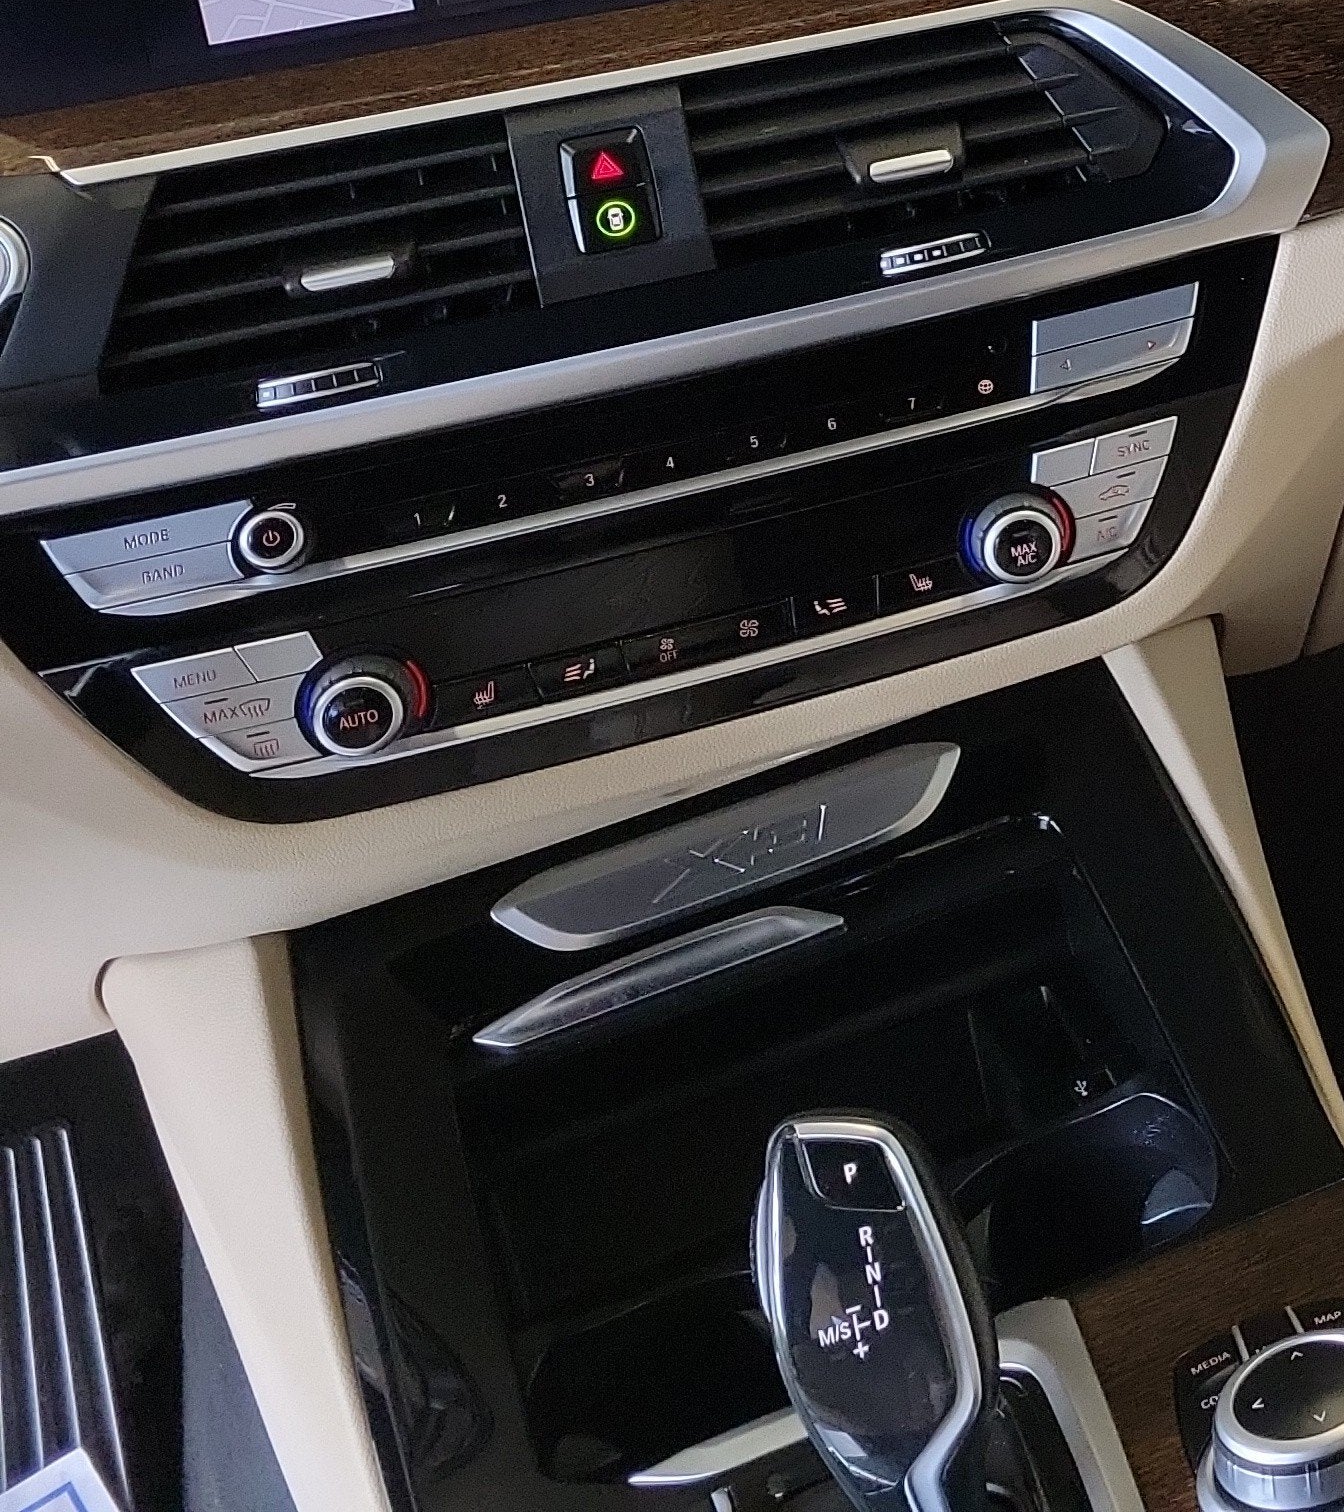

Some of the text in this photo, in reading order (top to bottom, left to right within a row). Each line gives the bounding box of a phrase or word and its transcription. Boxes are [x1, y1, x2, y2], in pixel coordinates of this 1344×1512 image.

[1117, 439, 1152, 457] SYNC
[413, 396, 917, 527] 1 2 3 4 5 6 7
[123, 528, 171, 551] MODE
[1010, 541, 1039, 558] MAX
[1016, 551, 1038, 567] A/C
[141, 563, 186, 585] BAND
[173, 669, 218, 690] MENU
[203, 705, 239, 725] MAX
[338, 708, 379, 731] AUTO
[843, 1162, 858, 1185] P
[858, 1225, 875, 1248] R
[865, 1260, 882, 1286] N
[873, 1308, 890, 1332] D
[1313, 1309, 1343, 1326] MAP
[817, 1320, 852, 1348] M/S
[1189, 1349, 1232, 1376] MEDIA
[1200, 1392, 1220, 1411] CO
